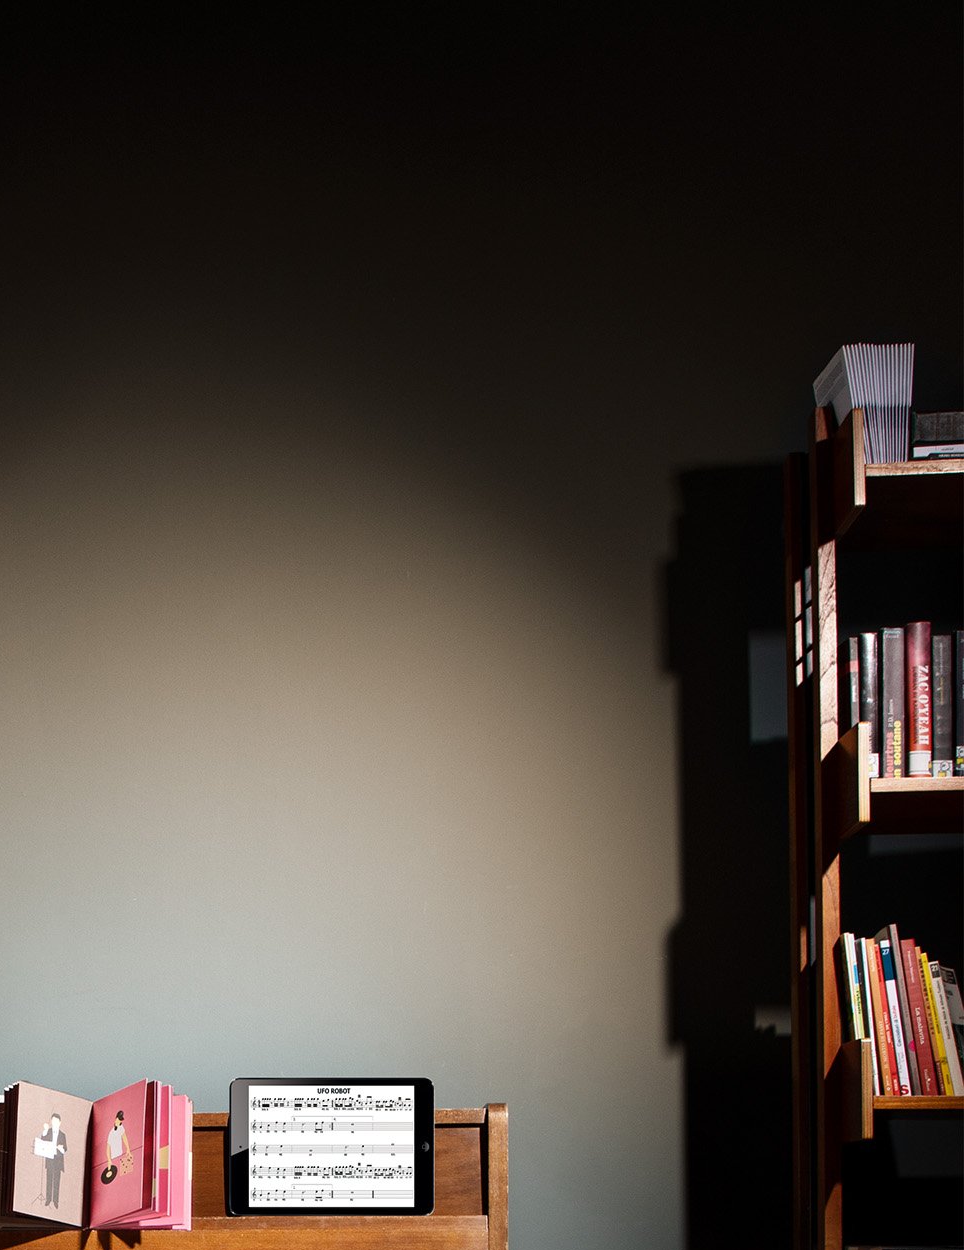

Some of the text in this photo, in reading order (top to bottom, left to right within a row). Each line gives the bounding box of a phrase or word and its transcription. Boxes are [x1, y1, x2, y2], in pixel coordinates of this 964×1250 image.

[917, 665, 930, 746] ZAC O'YEAH
[892, 720, 902, 766] soutane
[317, 1087, 351, 1095] UFO ROBOT
